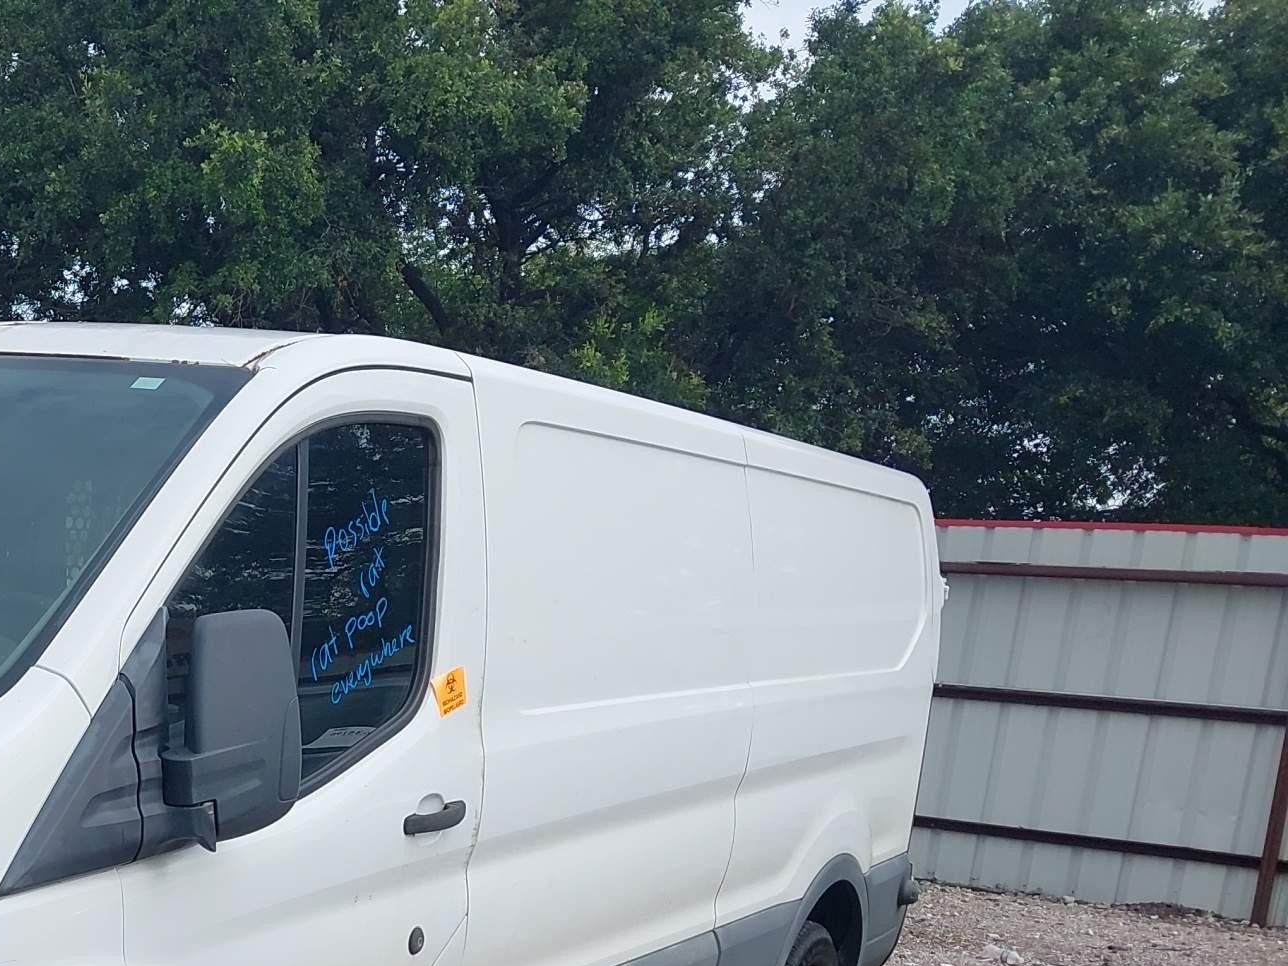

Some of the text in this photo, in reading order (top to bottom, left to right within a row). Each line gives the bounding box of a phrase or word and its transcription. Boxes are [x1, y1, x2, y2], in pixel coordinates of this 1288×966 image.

[311, 597, 388, 681] rat poop
[331, 624, 416, 704] everywhere
